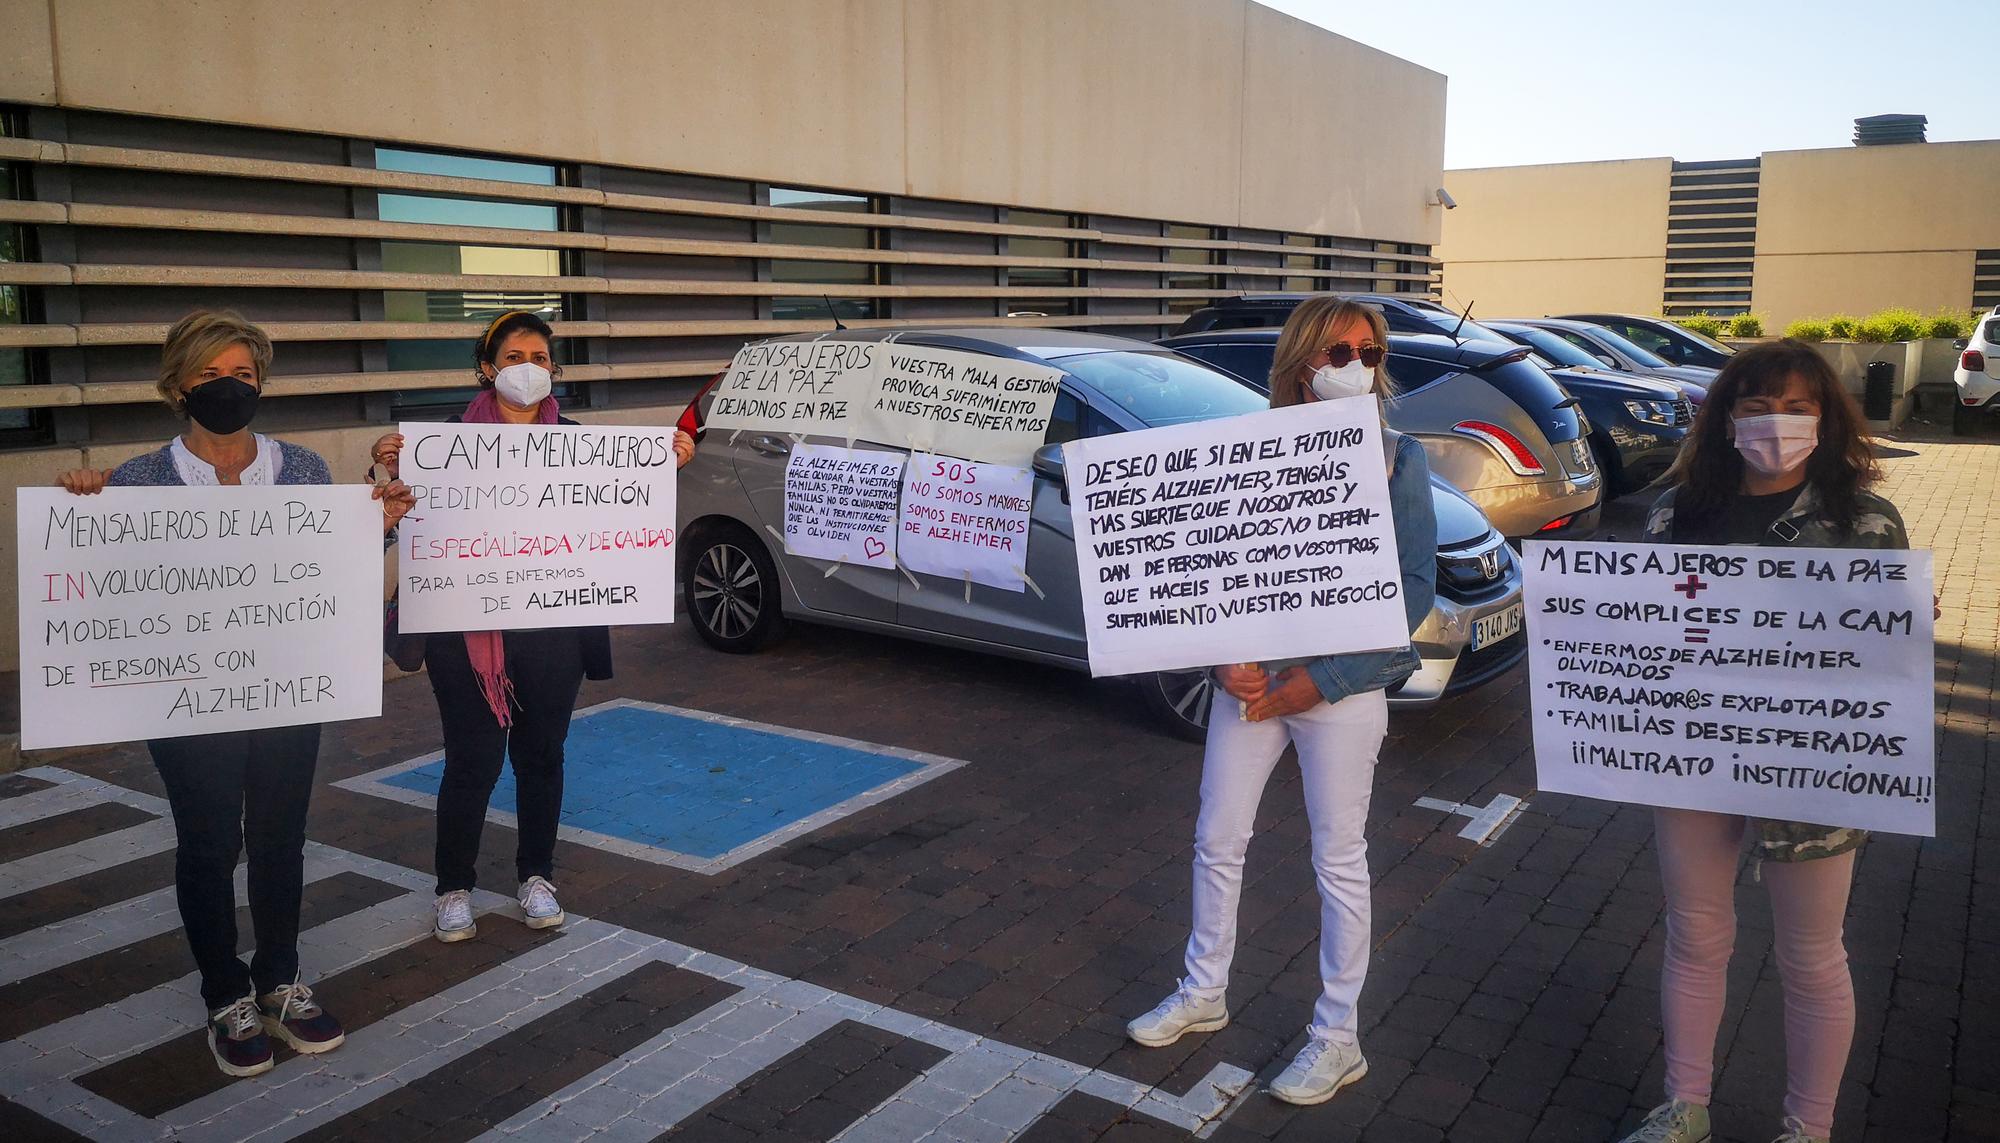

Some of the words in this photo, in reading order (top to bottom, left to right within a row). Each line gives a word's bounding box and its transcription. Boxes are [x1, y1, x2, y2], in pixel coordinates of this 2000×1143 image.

[737, 344, 874, 369] MENSAJEROS
[732, 370, 755, 390] DE
[757, 370, 778, 392] LA
[890, 355, 954, 381] VUESTRA
[961, 367, 997, 389] MALA
[1004, 376, 1060, 395] GESTIÓN
[716, 398, 787, 419] DEJADNOS
[791, 402, 815, 419] EN
[820, 401, 848, 421] PAZ
[882, 377, 938, 399] PROVOCA
[942, 388, 1036, 415] SUFRIMIENTO
[874, 398, 883, 410] A
[887, 399, 963, 423] NUESTROS
[964, 411, 1047, 432] ENFERMOS
[414, 433, 501, 470] CAM
[525, 432, 668, 469] MENSAJEROS
[792, 456, 804, 467] EL
[807, 457, 878, 475] ALZHEIMER
[881, 465, 898, 476] OS
[1085, 454, 1157, 486] DESEO
[1204, 445, 1223, 466] SI
[1229, 440, 1254, 464] EN
[1258, 437, 1286, 460] EL
[1293, 427, 1364, 456] FUTURO
[410, 484, 529, 511] PEDIMOS
[538, 478, 650, 508] ATENCIÓN
[787, 480, 829, 493] FAMILIAS,
[831, 484, 853, 495] PERO
[855, 488, 897, 500] VUESTRAS
[788, 468, 810, 479] HACE
[812, 470, 844, 483] OLVIDAR
[847, 474, 854, 484] A
[860, 477, 898, 489] VUESTRAS
[1086, 482, 1146, 512] TENÉIS
[1152, 470, 1273, 502] ALZHEIMER,
[1276, 454, 1350, 487] TENGÁIS
[787, 491, 823, 504] FAMILIAS
[827, 496, 836, 505] NO
[839, 497, 848, 506] OS
[851, 499, 896, 511] OLVIDAREMOS
[910, 481, 930, 496] NO
[936, 486, 982, 506] SOMOS
[987, 494, 1031, 512] MAYORES
[1089, 513, 1126, 535] MAS
[1130, 504, 1188, 530] SUERTE
[1191, 499, 1230, 520] QUE
[1237, 486, 1337, 517] NOSOTROS
[1342, 482, 1358, 503] Y
[45, 506, 208, 550] MENSAJEROS
[218, 510, 240, 538] DE
[250, 511, 274, 536] LA
[284, 501, 332, 535] PAZ
[788, 513, 803, 523] QUE
[807, 515, 818, 524] LAS
[825, 519, 887, 533] INSTITUCIONES
[820, 507, 829, 516] NI
[833, 508, 891, 523] PERMITIREMOS
[906, 503, 945, 522] SOMOS
[951, 512, 1025, 533] ENFERMOS
[411, 531, 573, 561] ESPECIALIZADA
[577, 534, 587, 549] Y
[590, 531, 611, 551] DE
[614, 527, 675, 550] CALIDAD
[787, 525, 798, 534] OS
[807, 527, 850, 541] OLVIDEN
[905, 522, 921, 534] DE
[928, 526, 1012, 552] ALZHEIMER
[1093, 531, 1176, 559] VUESTROS
[1185, 517, 1281, 546] CUIDADOS
[1281, 516, 1310, 536] NO
[1100, 563, 1130, 583] DAN
[1144, 559, 1164, 577] DE
[1167, 550, 1239, 574] PERSONAS
[1245, 544, 1290, 564] COMO
[1294, 537, 1379, 559] VOSOTROS,
[1540, 547, 1748, 577] MENSAJEROS
[1759, 559, 1796, 579] DE
[1806, 560, 1836, 582] LA
[1847, 559, 1908, 583] PAZ
[41, 563, 256, 602] INVOLUCIONANDO
[273, 562, 321, 584] LOS
[409, 576, 455, 594] PARA
[467, 571, 498, 586] LOS
[506, 567, 585, 584] ENFERMOS
[1104, 587, 1139, 605] QUE
[1149, 574, 1209, 600] HACÉIS
[1223, 574, 1249, 592] DE
[1254, 566, 1343, 588] NUESTRO
[480, 596, 511, 614] DE
[525, 582, 638, 610] ALZHEIMER
[1106, 603, 1216, 630] SUFRIMIENTO
[1218, 592, 1302, 619] VUESTRO
[1311, 580, 1397, 608] NEGOCIO
[1541, 597, 1585, 616] SUS
[1595, 601, 1741, 625] COMPLICES
[1754, 610, 1788, 630] DE
[1799, 610, 1826, 631] LA
[46, 614, 171, 646] MODELOS
[187, 611, 211, 633] DE
[225, 593, 336, 629] ATENCIÓN
[1478, 615, 1502, 644] 3140
[1504, 608, 1518, 633] JXS
[42, 665, 75, 687] DE
[89, 653, 201, 684] PERSONAS
[215, 649, 255, 672] CON
[1554, 640, 1666, 661] ENFERMOS
[1668, 648, 1696, 664] DE
[1699, 641, 1861, 669] ALZHEIMER
[1557, 656, 1675, 681] OLVIDADOS
[167, 675, 336, 719] ALZHEIMER
[1555, 681, 1714, 711] TRABAJADOR@S
[1721, 694, 1891, 720] EXPLOTADOS
[1559, 708, 1676, 735] FAMILIAS
[1686, 722, 1908, 757] DESESPERADAS
[1732, 753, 1932, 804] INSTITUCIONAL!!
